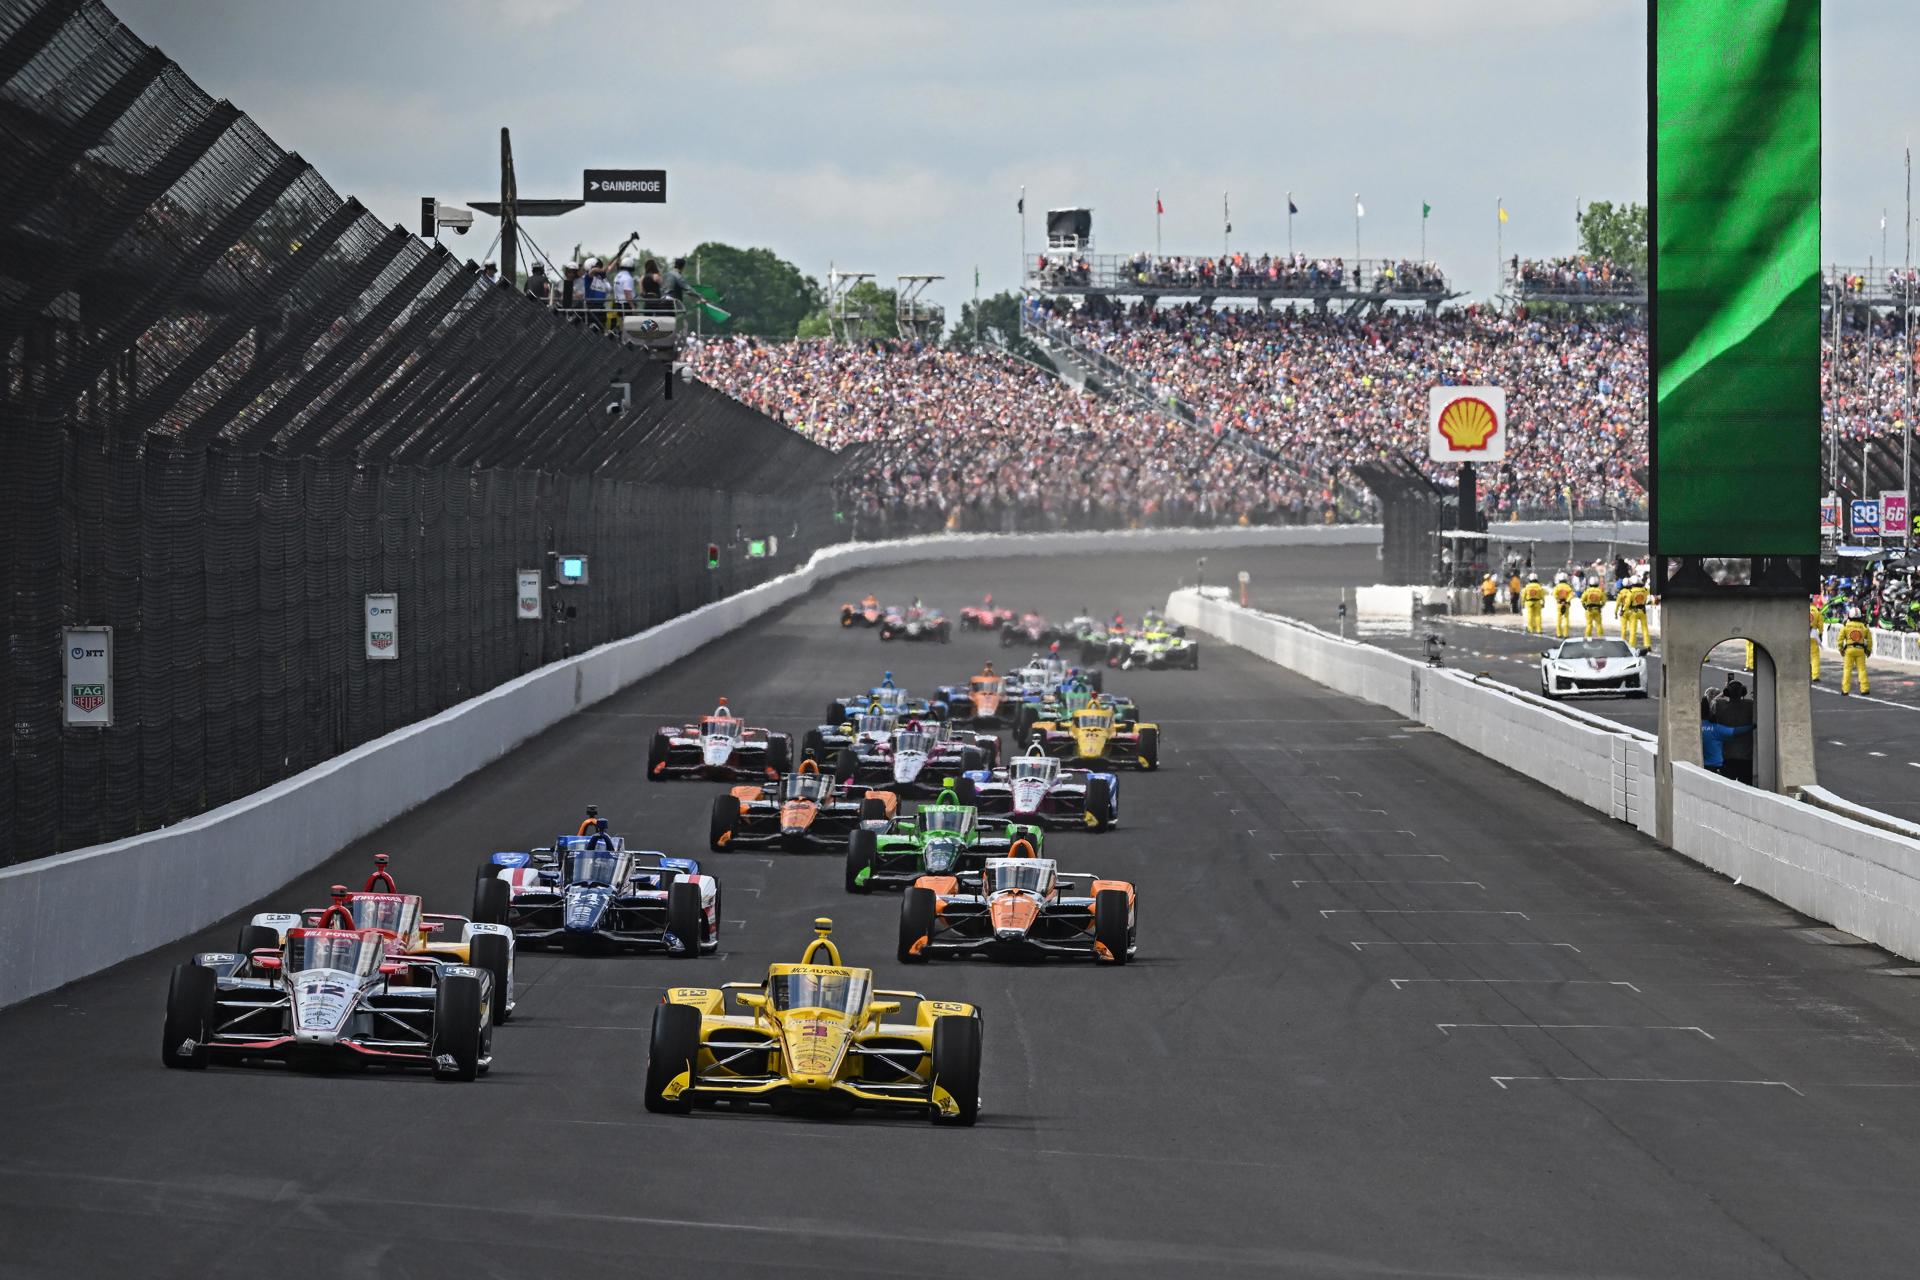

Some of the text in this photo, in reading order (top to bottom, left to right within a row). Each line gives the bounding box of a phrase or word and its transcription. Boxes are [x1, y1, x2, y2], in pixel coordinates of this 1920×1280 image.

[601, 180, 661, 192] GAINBRIDGE
[1886, 507, 1905, 522] 66
[85, 649, 104, 658] NTT
[75, 686, 102, 696] TAG
[73, 696, 103, 710] HEUER
[325, 931, 361, 941] POWER
[205, 954, 235, 962] PPG
[303, 983, 346, 998] 12
[802, 1025, 828, 1038] 3
